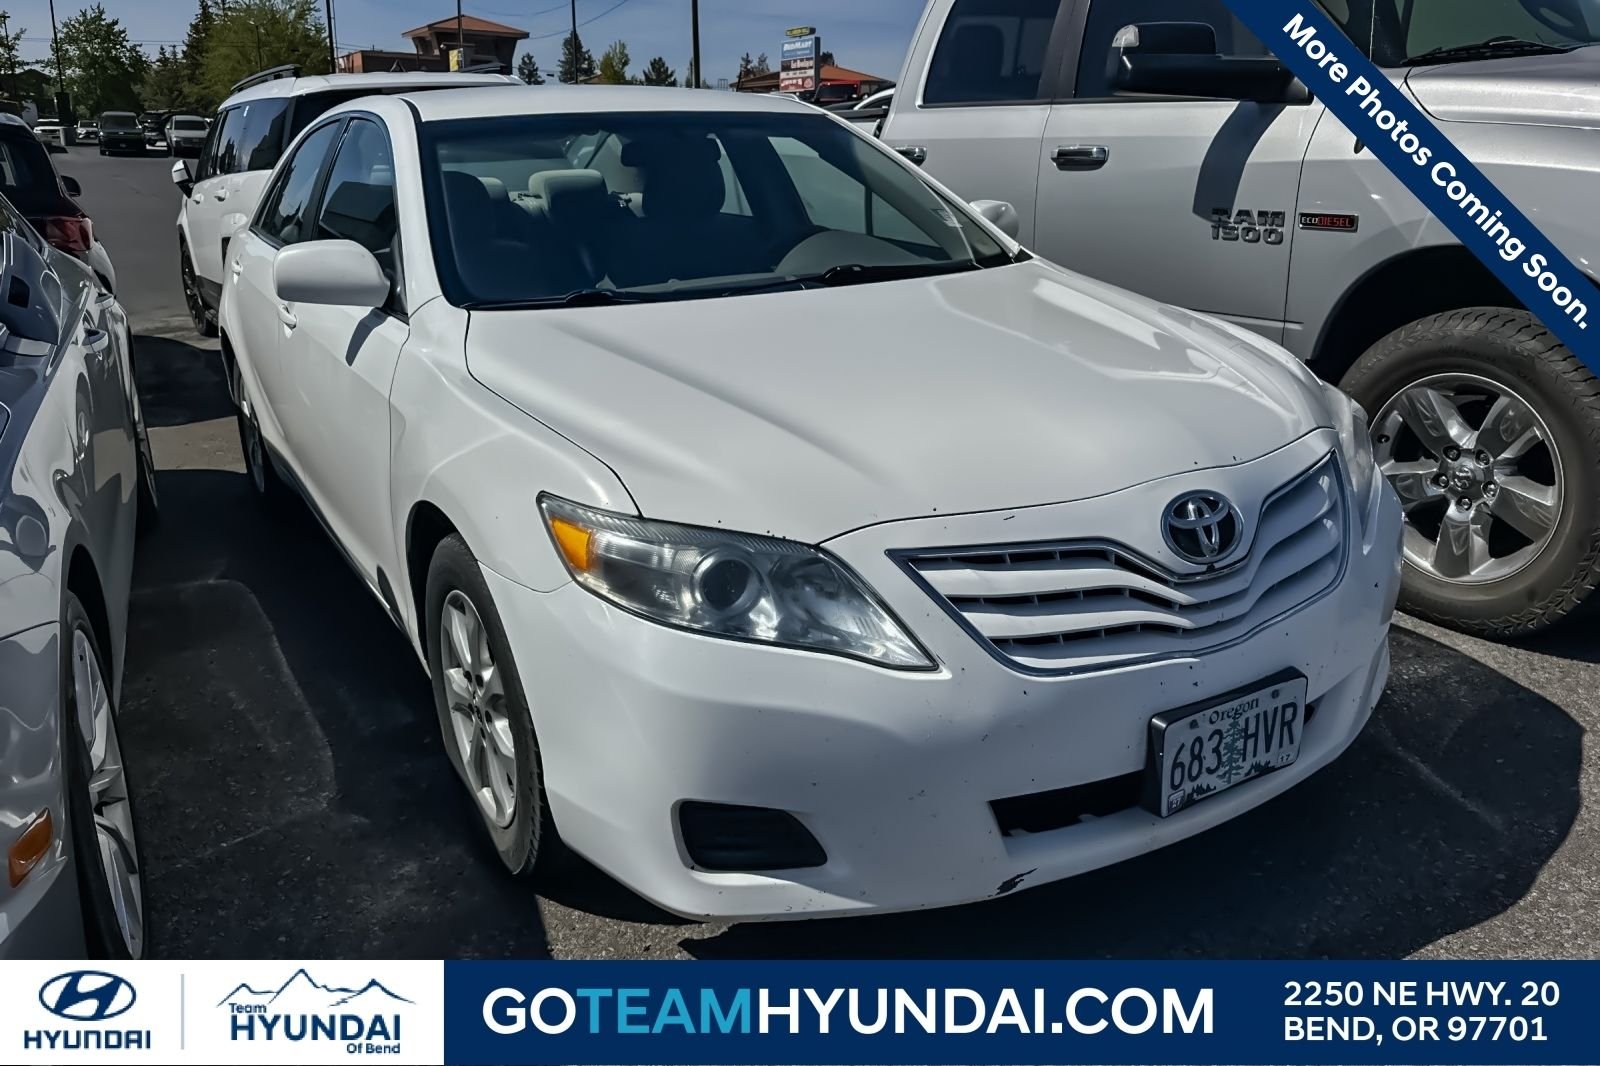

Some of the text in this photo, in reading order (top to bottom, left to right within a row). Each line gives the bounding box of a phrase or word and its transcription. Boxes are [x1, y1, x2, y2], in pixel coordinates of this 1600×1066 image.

[1211, 208, 1285, 227] RAM
[1300, 215, 1352, 228] ECODIESEL
[1211, 225, 1284, 245] 1500
[1208, 697, 1260, 724] Oregon
[1170, 702, 1298, 790] 683 HVR
